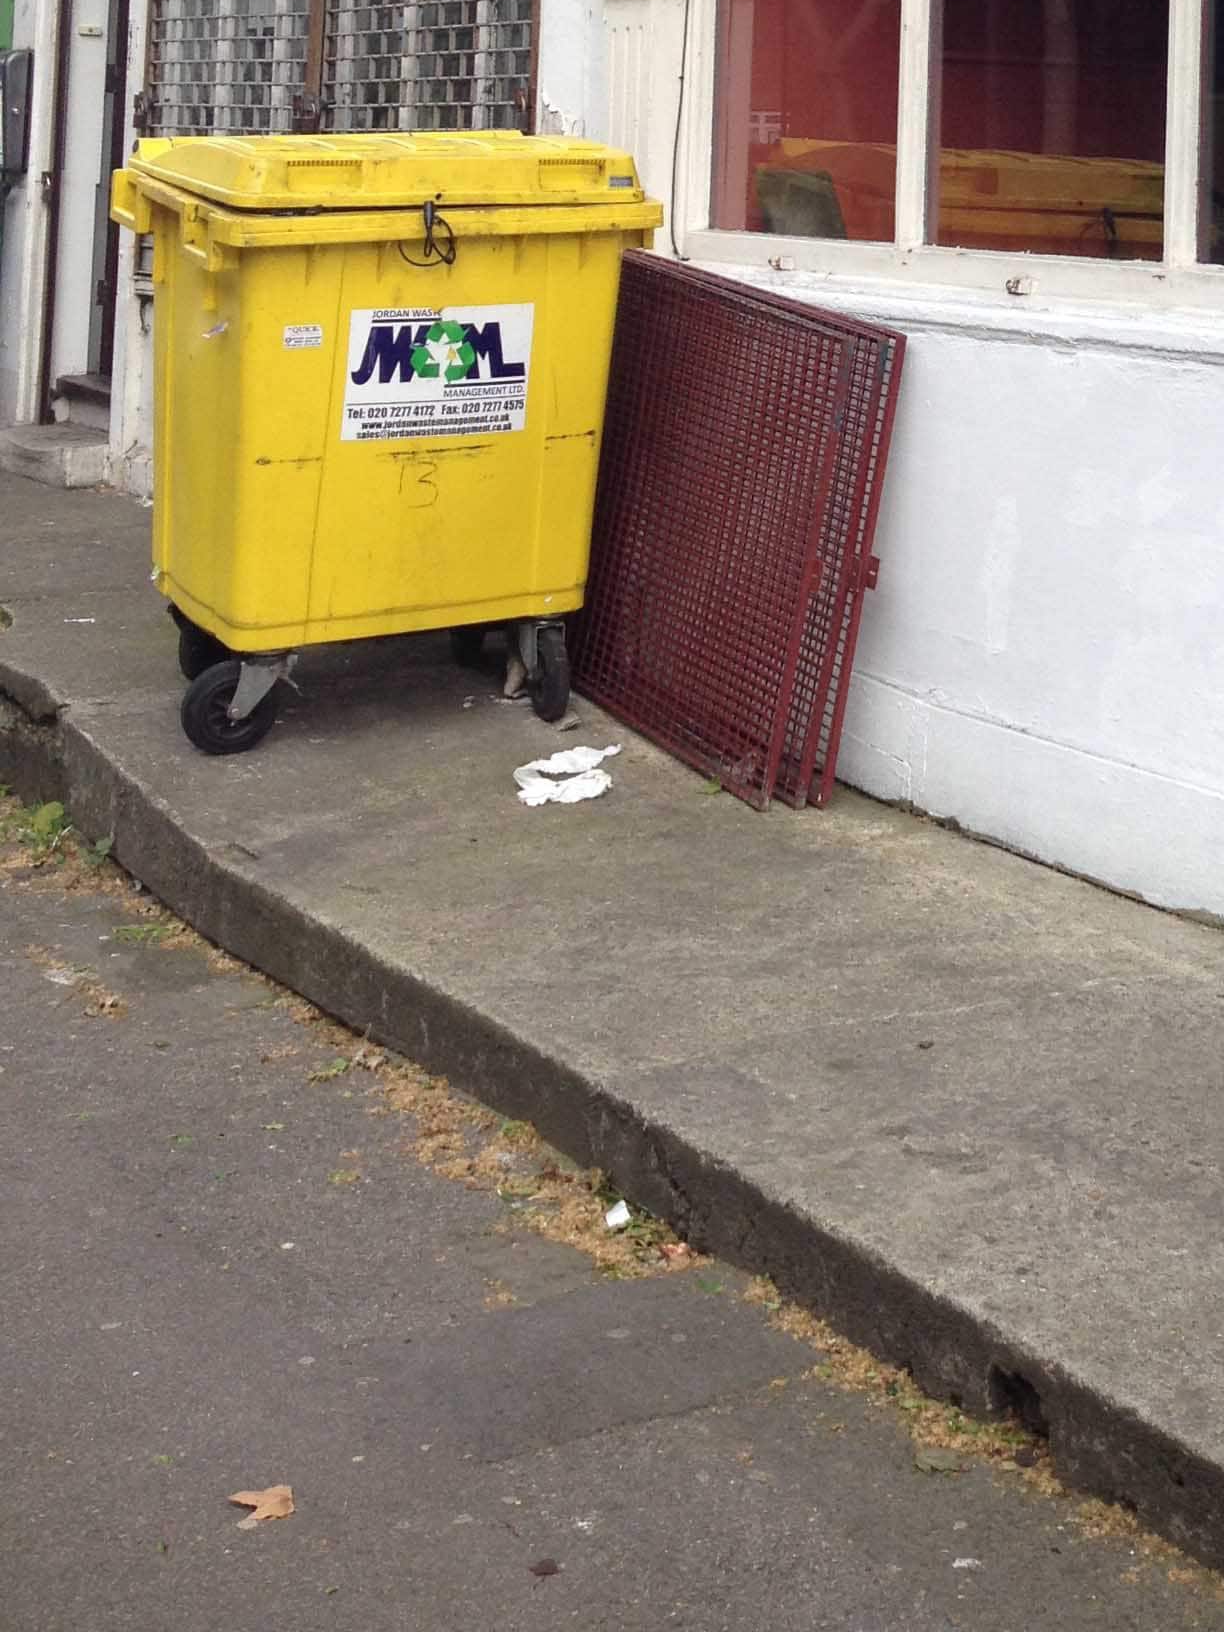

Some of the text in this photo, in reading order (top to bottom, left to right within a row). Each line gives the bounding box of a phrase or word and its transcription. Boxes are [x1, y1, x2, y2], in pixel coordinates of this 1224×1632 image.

[372, 309, 410, 319] JORDAN
[443, 386, 508, 398] MANAGEMENT
[347, 399, 524, 419] Tel: 020 7277 4172 Fax: 020 7277 4575
